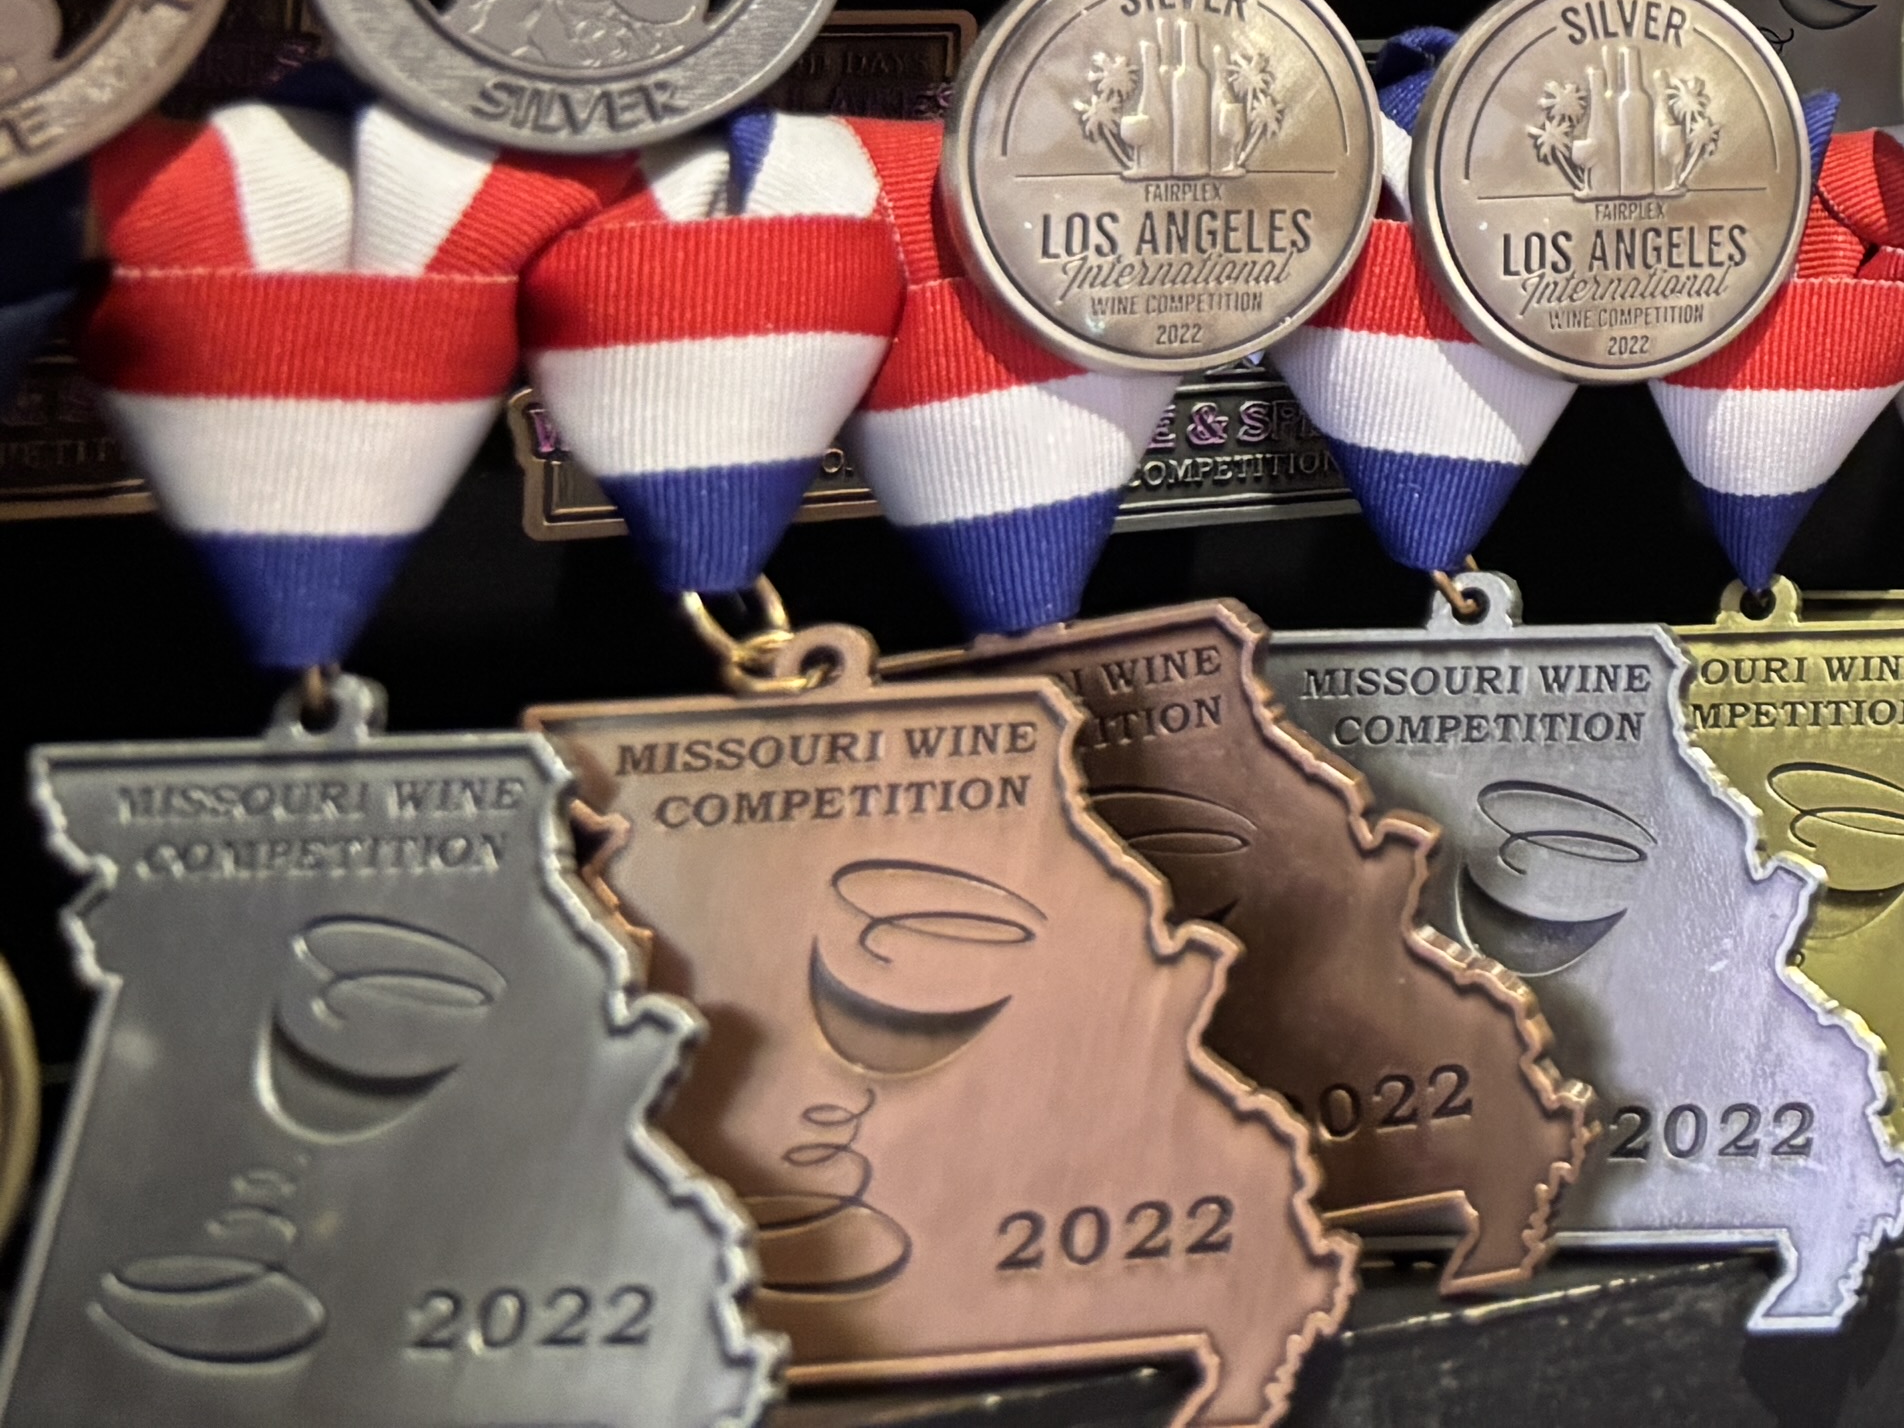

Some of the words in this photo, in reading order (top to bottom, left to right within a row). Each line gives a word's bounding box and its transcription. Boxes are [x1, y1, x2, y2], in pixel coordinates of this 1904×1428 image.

[475, 82, 687, 136] SILVER
[1144, 182, 1225, 204] FAIRPLEX
[1042, 209, 1122, 252] LOS
[1138, 206, 1312, 250] ANGELES
[1059, 249, 1295, 304] International
[1091, 294, 1140, 316] WINE
[1145, 290, 1264, 314] COMPETITION
[1155, 324, 1204, 345] 2022
[1301, 663, 1529, 699] MISSOURI
[1539, 663, 1653, 696] WINE
[615, 727, 884, 778] MISSOURI
[895, 720, 1039, 761] WINE
[1332, 708, 1646, 745] COMPETITION
[652, 774, 1034, 832] COMPETITION
[1606, 1104, 1817, 1161] 2022
[995, 1196, 1238, 1272] 2022
